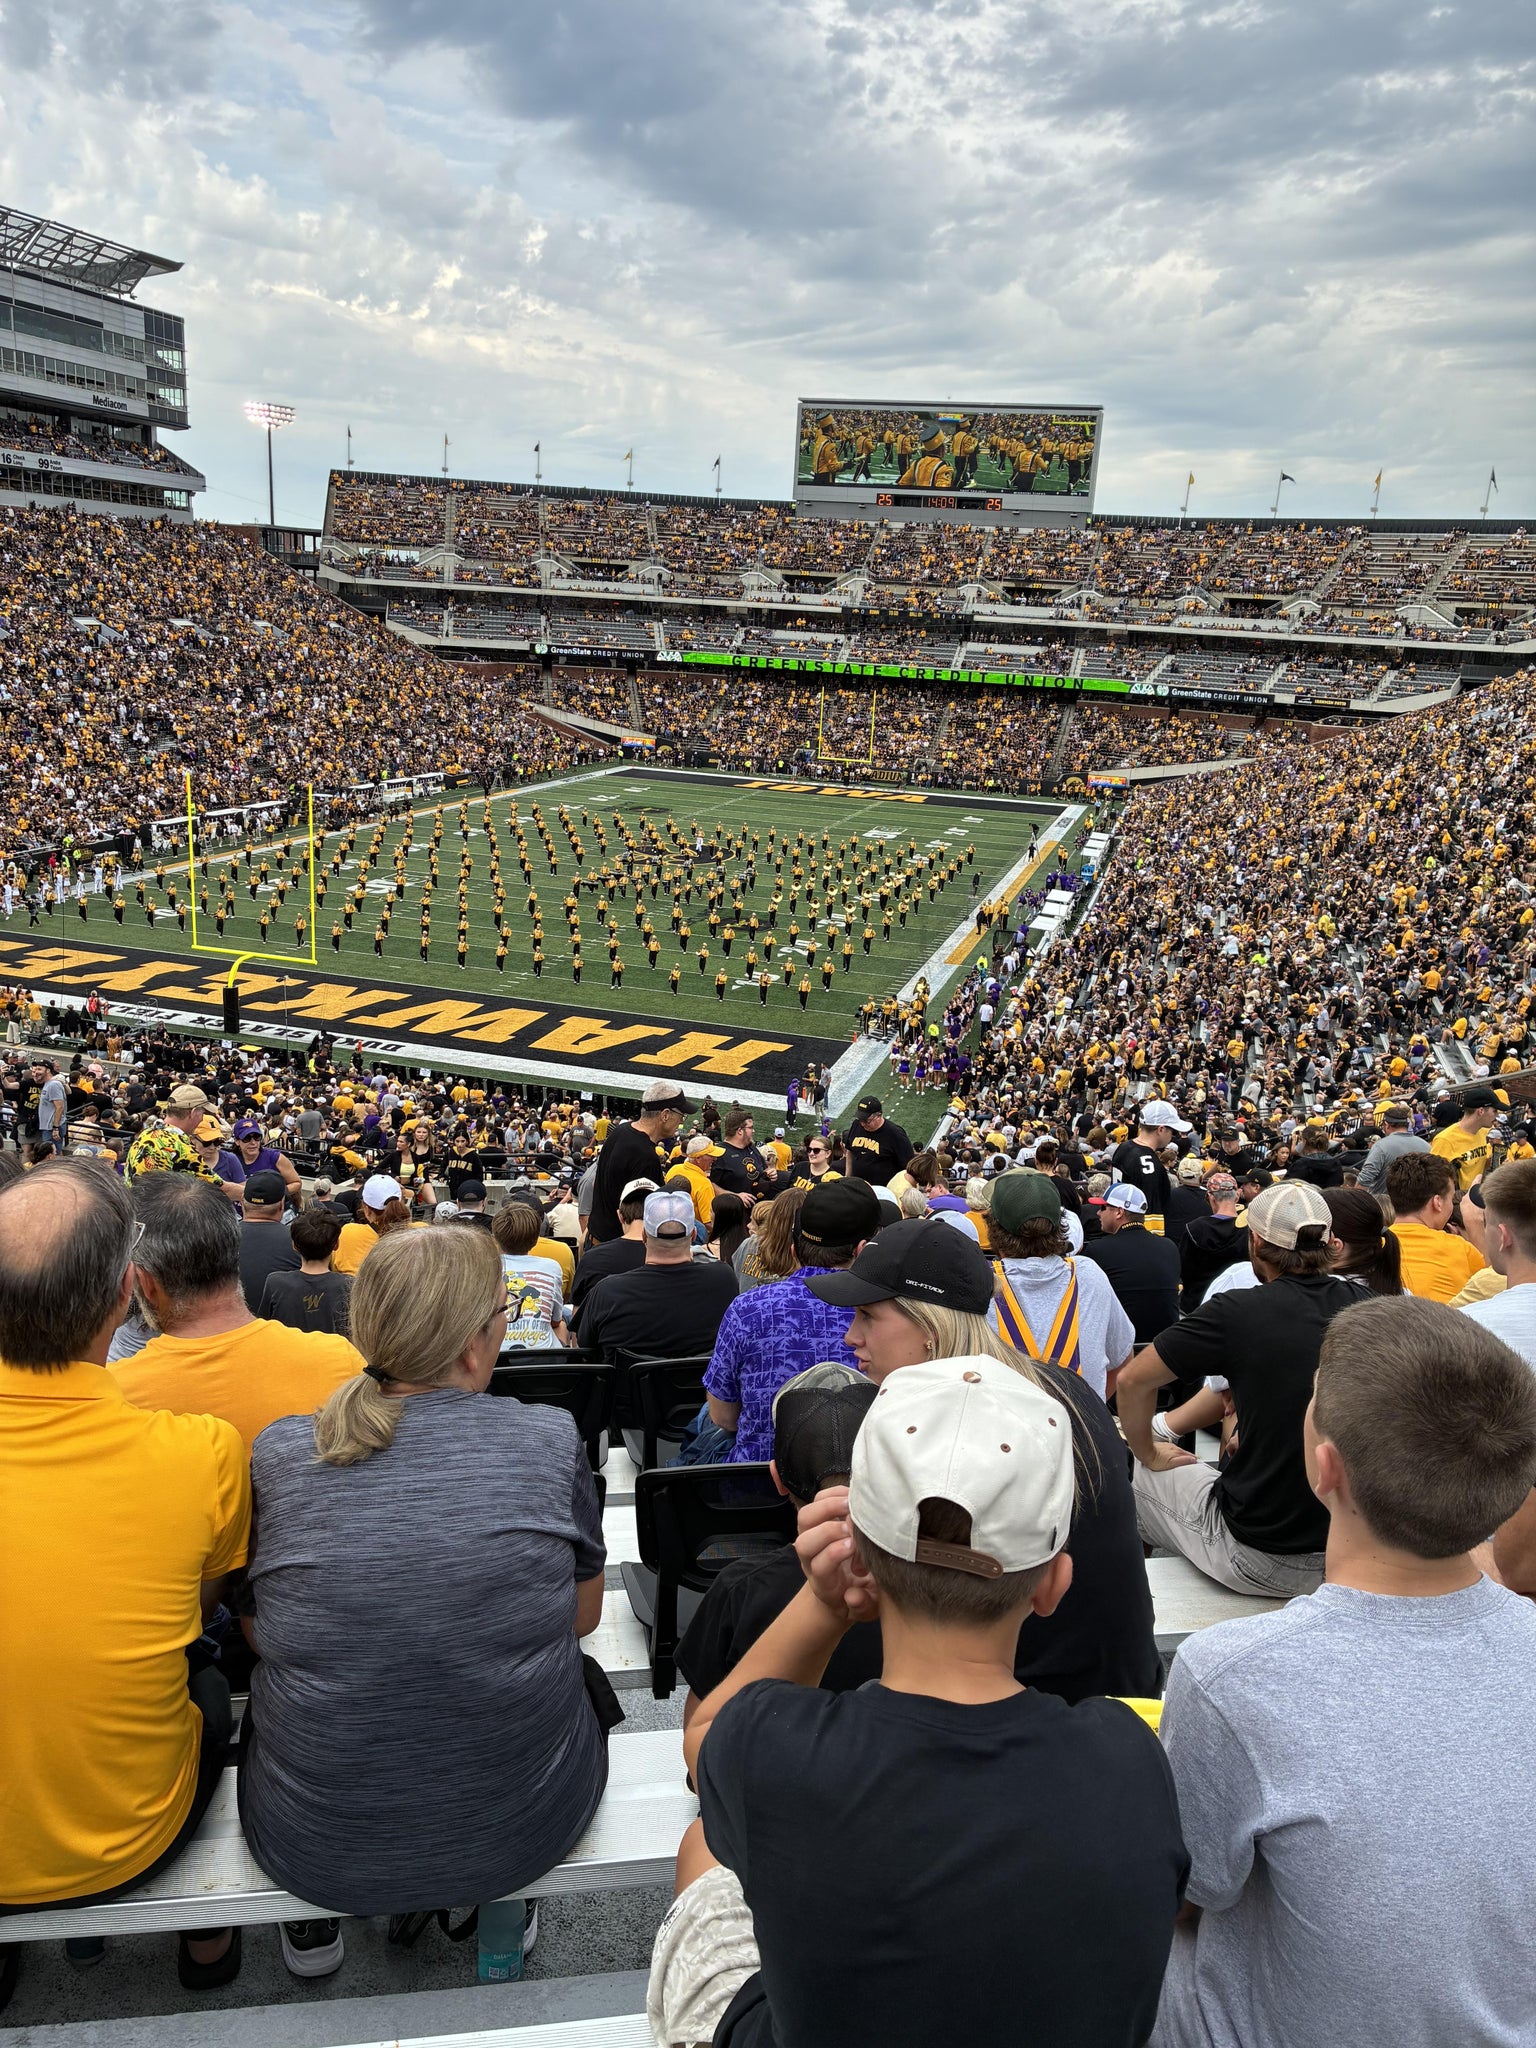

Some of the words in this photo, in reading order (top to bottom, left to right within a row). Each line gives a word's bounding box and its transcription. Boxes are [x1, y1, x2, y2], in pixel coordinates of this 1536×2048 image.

[92, 394, 128, 411] Mediacom
[2, 453, 12, 464] 16
[38, 458, 50, 469] 99
[878, 494, 892, 507] 25
[927, 496, 955, 509] 14:09
[987, 498, 1001, 511] 25
[550, 646, 591, 656] GreenState
[592, 649, 618, 657] CREDIT
[732, 655, 882, 677] GREENSTATE
[899, 667, 988, 684] CREDIT
[1005, 673, 1085, 690] UNION
[1171, 688, 1212, 699] GreenState
[1213, 692, 1240, 701] CREDIT
[1243, 695, 1268, 704] UNION
[735, 781, 929, 804] IOWA
[0, 940, 794, 1076] HAWKEYE
[851, 1136, 880, 1155] IOWA
[448, 1160, 473, 1172] IOWA
[1139, 1155, 1155, 1175] 5
